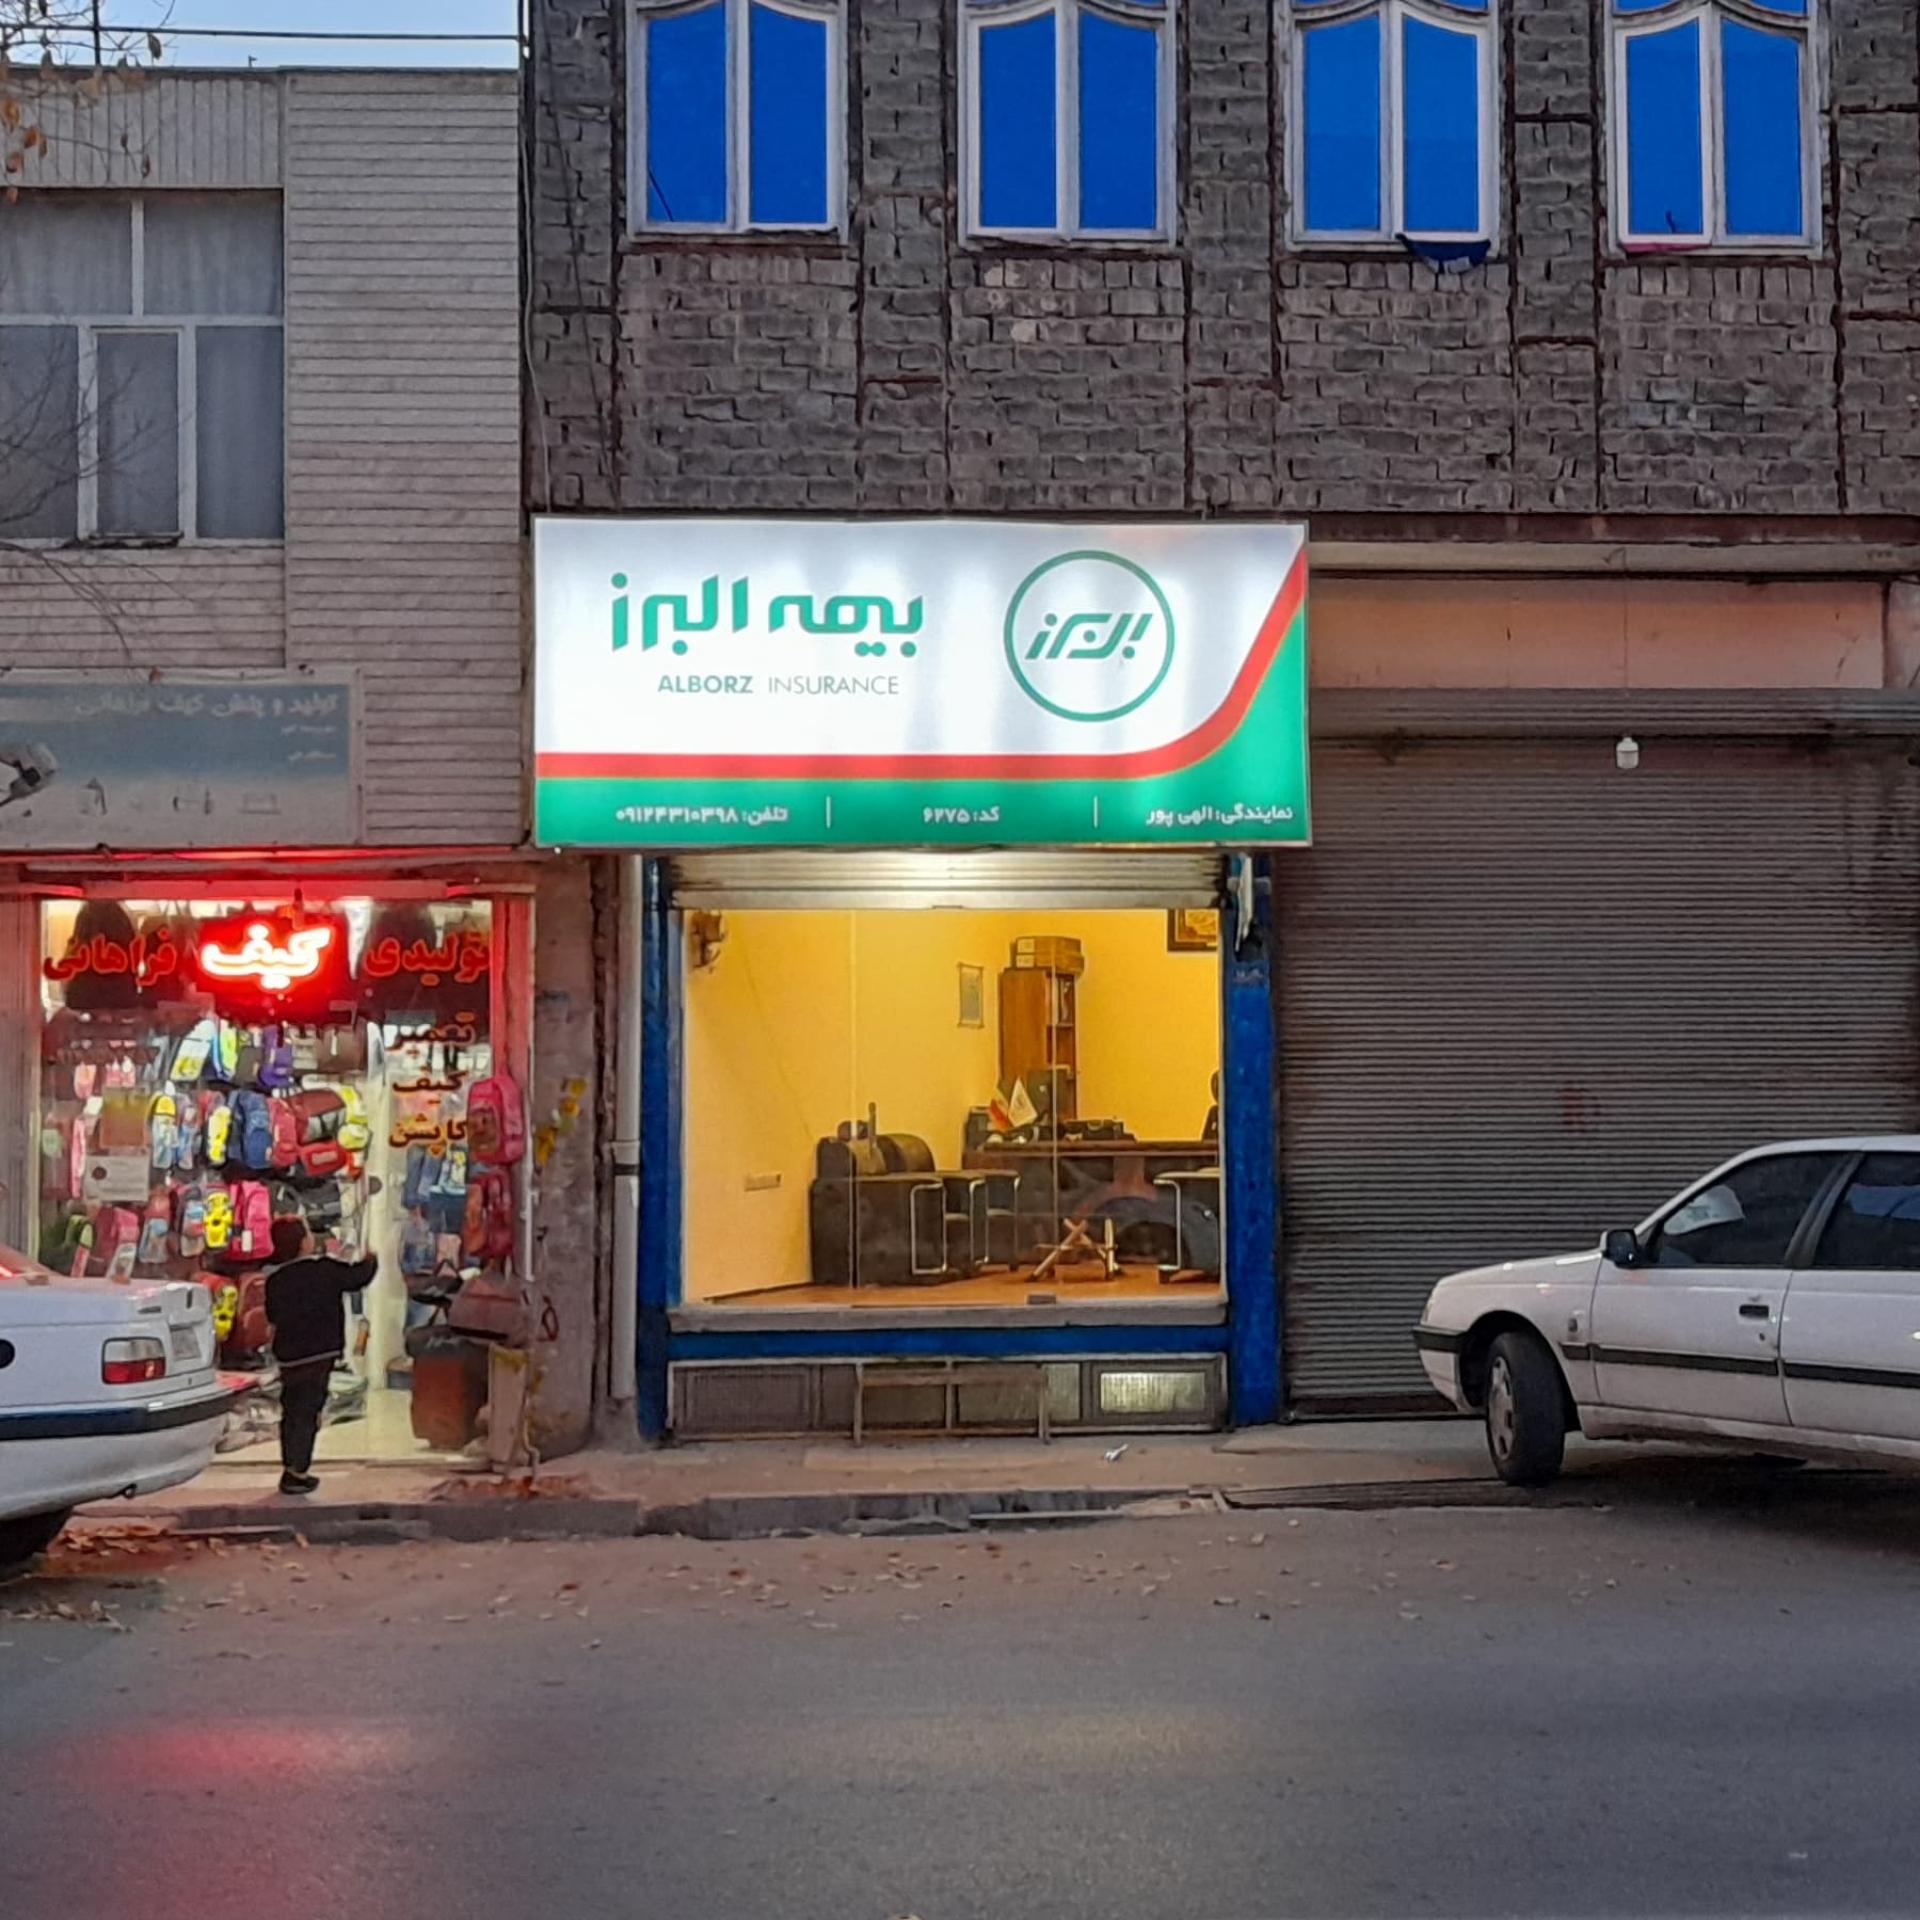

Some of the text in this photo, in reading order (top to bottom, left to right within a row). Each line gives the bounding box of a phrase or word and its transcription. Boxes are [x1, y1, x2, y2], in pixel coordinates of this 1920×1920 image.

[611, 572, 923, 657] بیمه البرز
[657, 675, 899, 695] ALBORZ INSURANCE
[1145, 809, 1173, 827] پور
[1177, 806, 1212, 824] الهی
[202, 924, 331, 990] کیف
[364, 929, 490, 986] تولیدی
[392, 1066, 469, 1105] کیف
